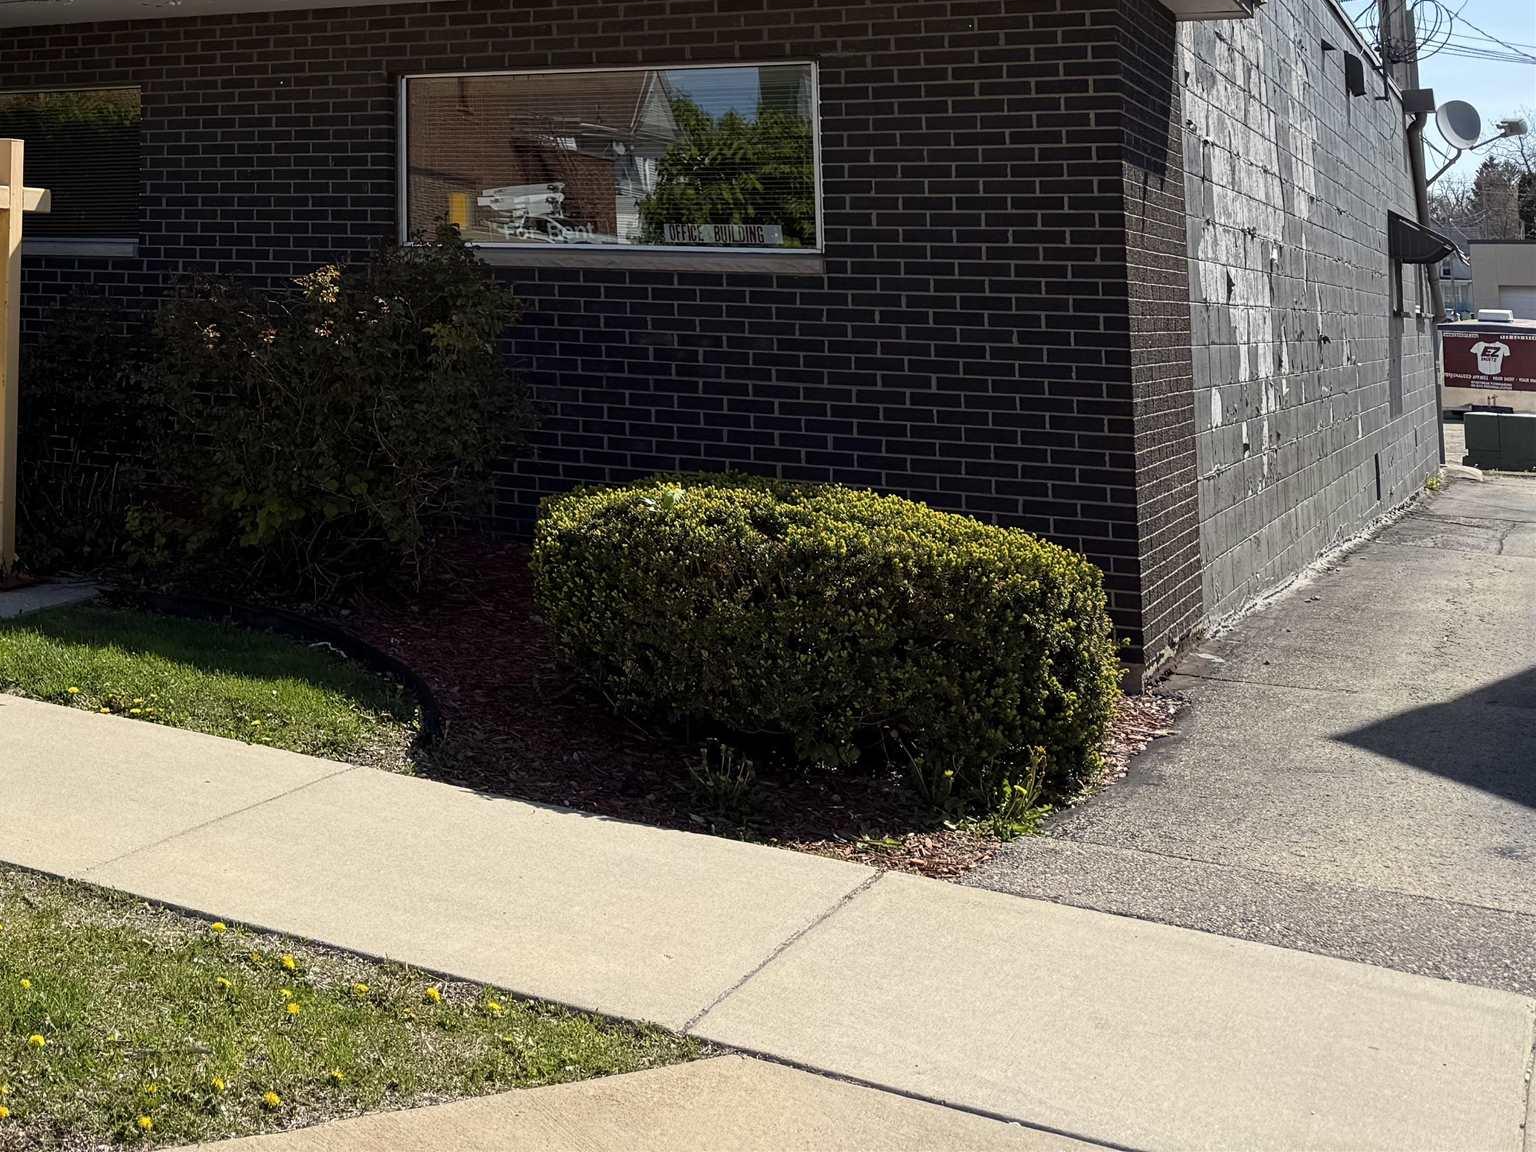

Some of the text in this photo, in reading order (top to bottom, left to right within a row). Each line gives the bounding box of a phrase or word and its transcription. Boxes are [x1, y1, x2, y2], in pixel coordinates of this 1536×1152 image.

[669, 224, 765, 243] OFFICE BUILDING
[1481, 346, 1502, 357] EZ
